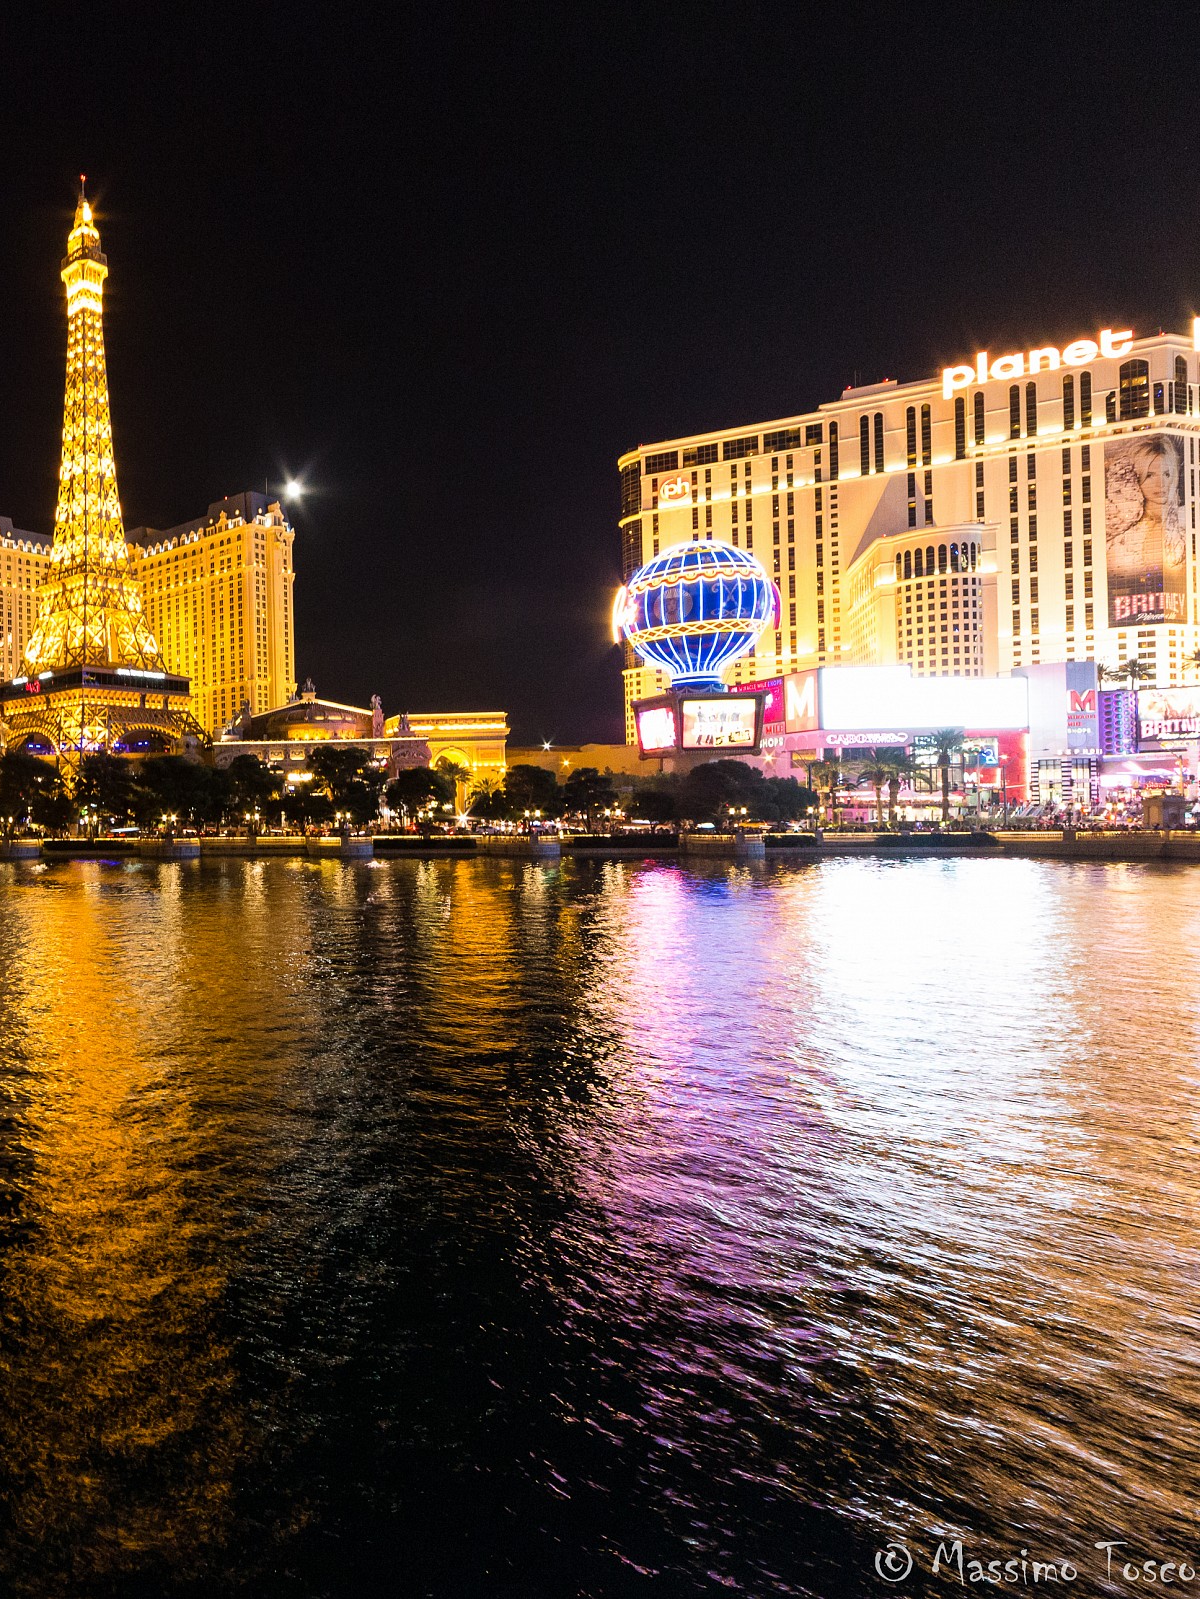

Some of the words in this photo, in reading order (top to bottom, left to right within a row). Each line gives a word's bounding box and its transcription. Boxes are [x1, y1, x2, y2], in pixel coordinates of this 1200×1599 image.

[942, 328, 1133, 400] planet
[1115, 592, 1185, 620] BRITNEY
[787, 676, 814, 720] M
[1066, 689, 1096, 712] M
